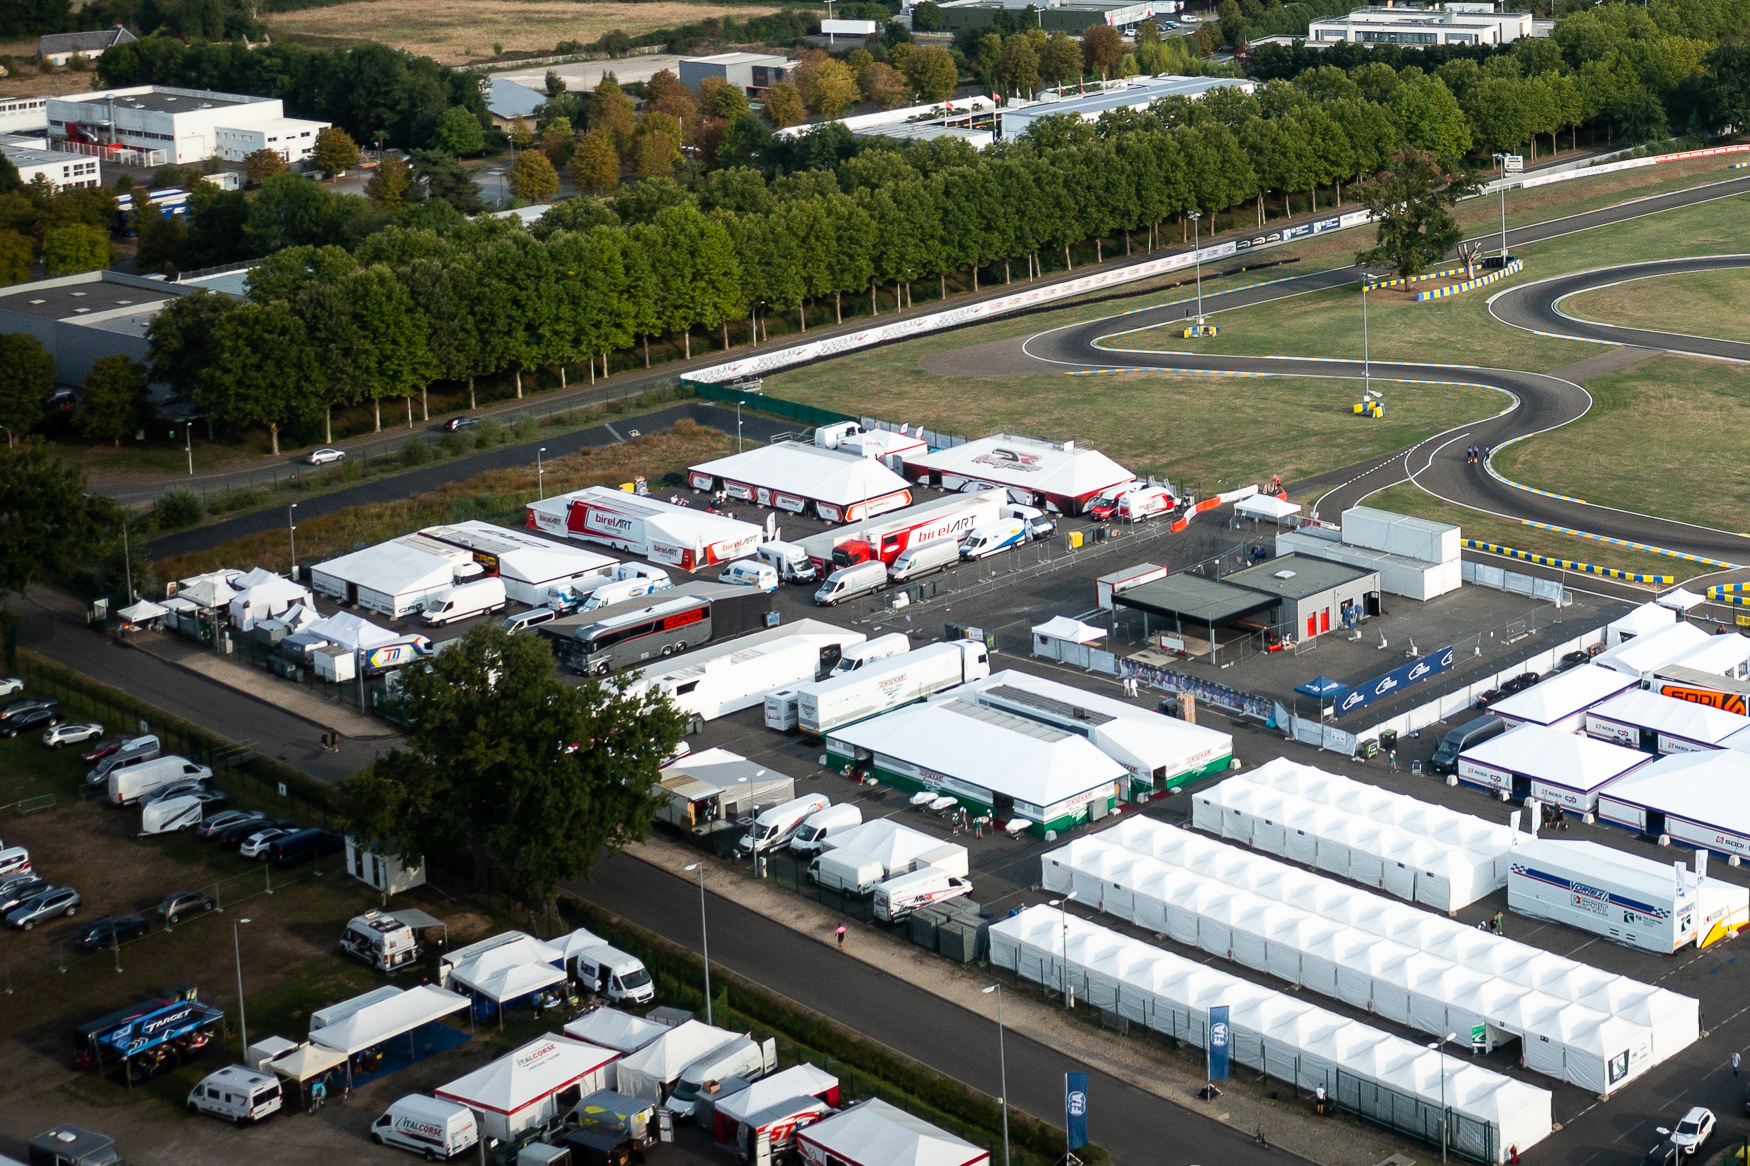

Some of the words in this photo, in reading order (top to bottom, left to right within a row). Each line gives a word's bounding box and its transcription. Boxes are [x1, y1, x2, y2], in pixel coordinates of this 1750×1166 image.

[595, 513, 633, 532] birelART
[918, 514, 977, 543] birelART
[722, 534, 758, 553] birelART
[145, 1008, 192, 1032] TARGET
